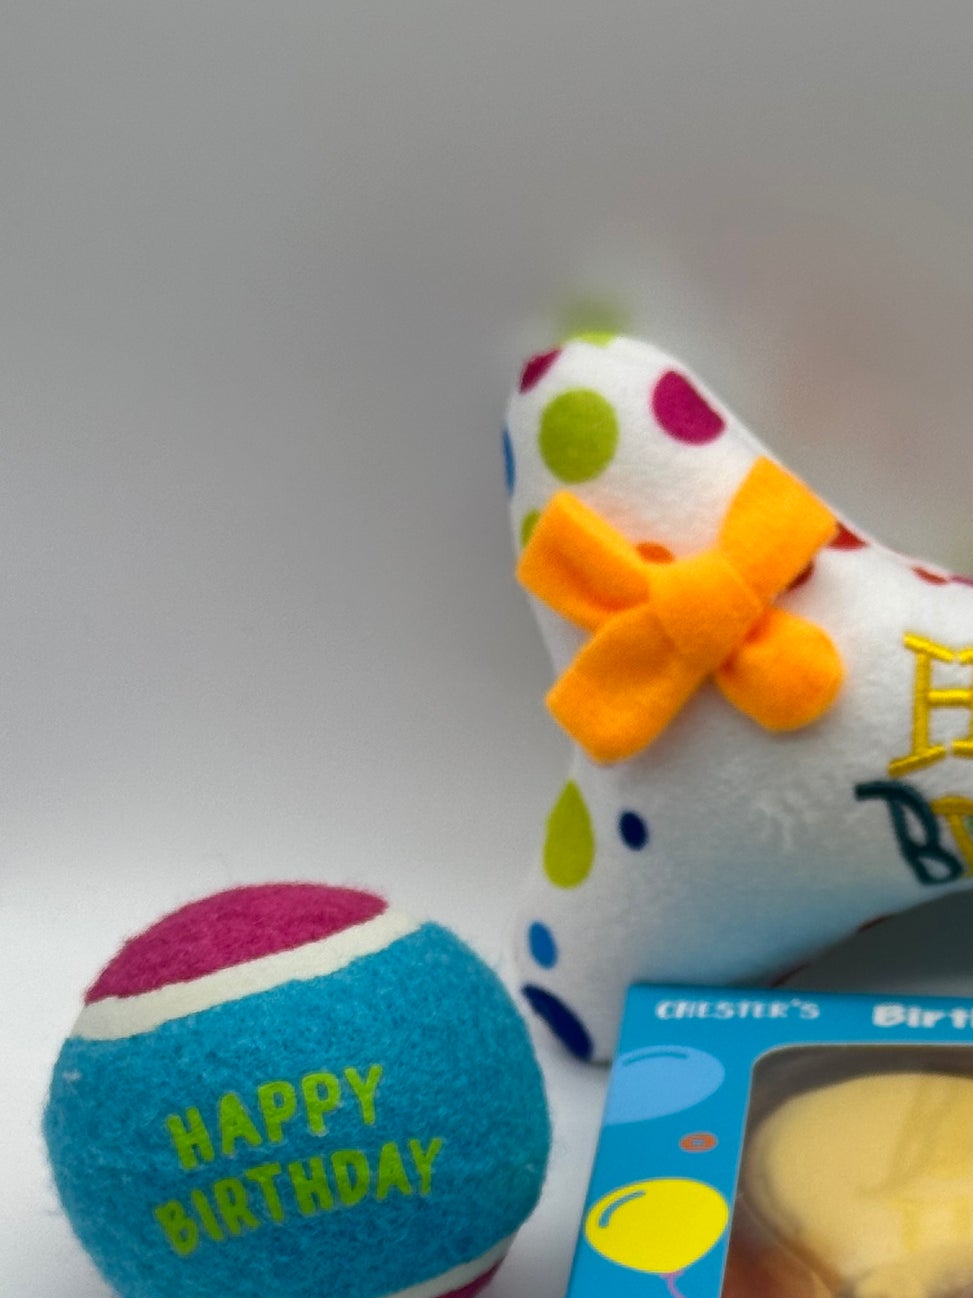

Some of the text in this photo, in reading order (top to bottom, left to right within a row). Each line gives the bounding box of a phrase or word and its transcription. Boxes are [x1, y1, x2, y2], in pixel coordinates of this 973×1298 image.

[655, 998, 820, 1021] CHESTER'S
[166, 1064, 383, 1171] HAPPY
[154, 1137, 442, 1257] BIRTHDAY
